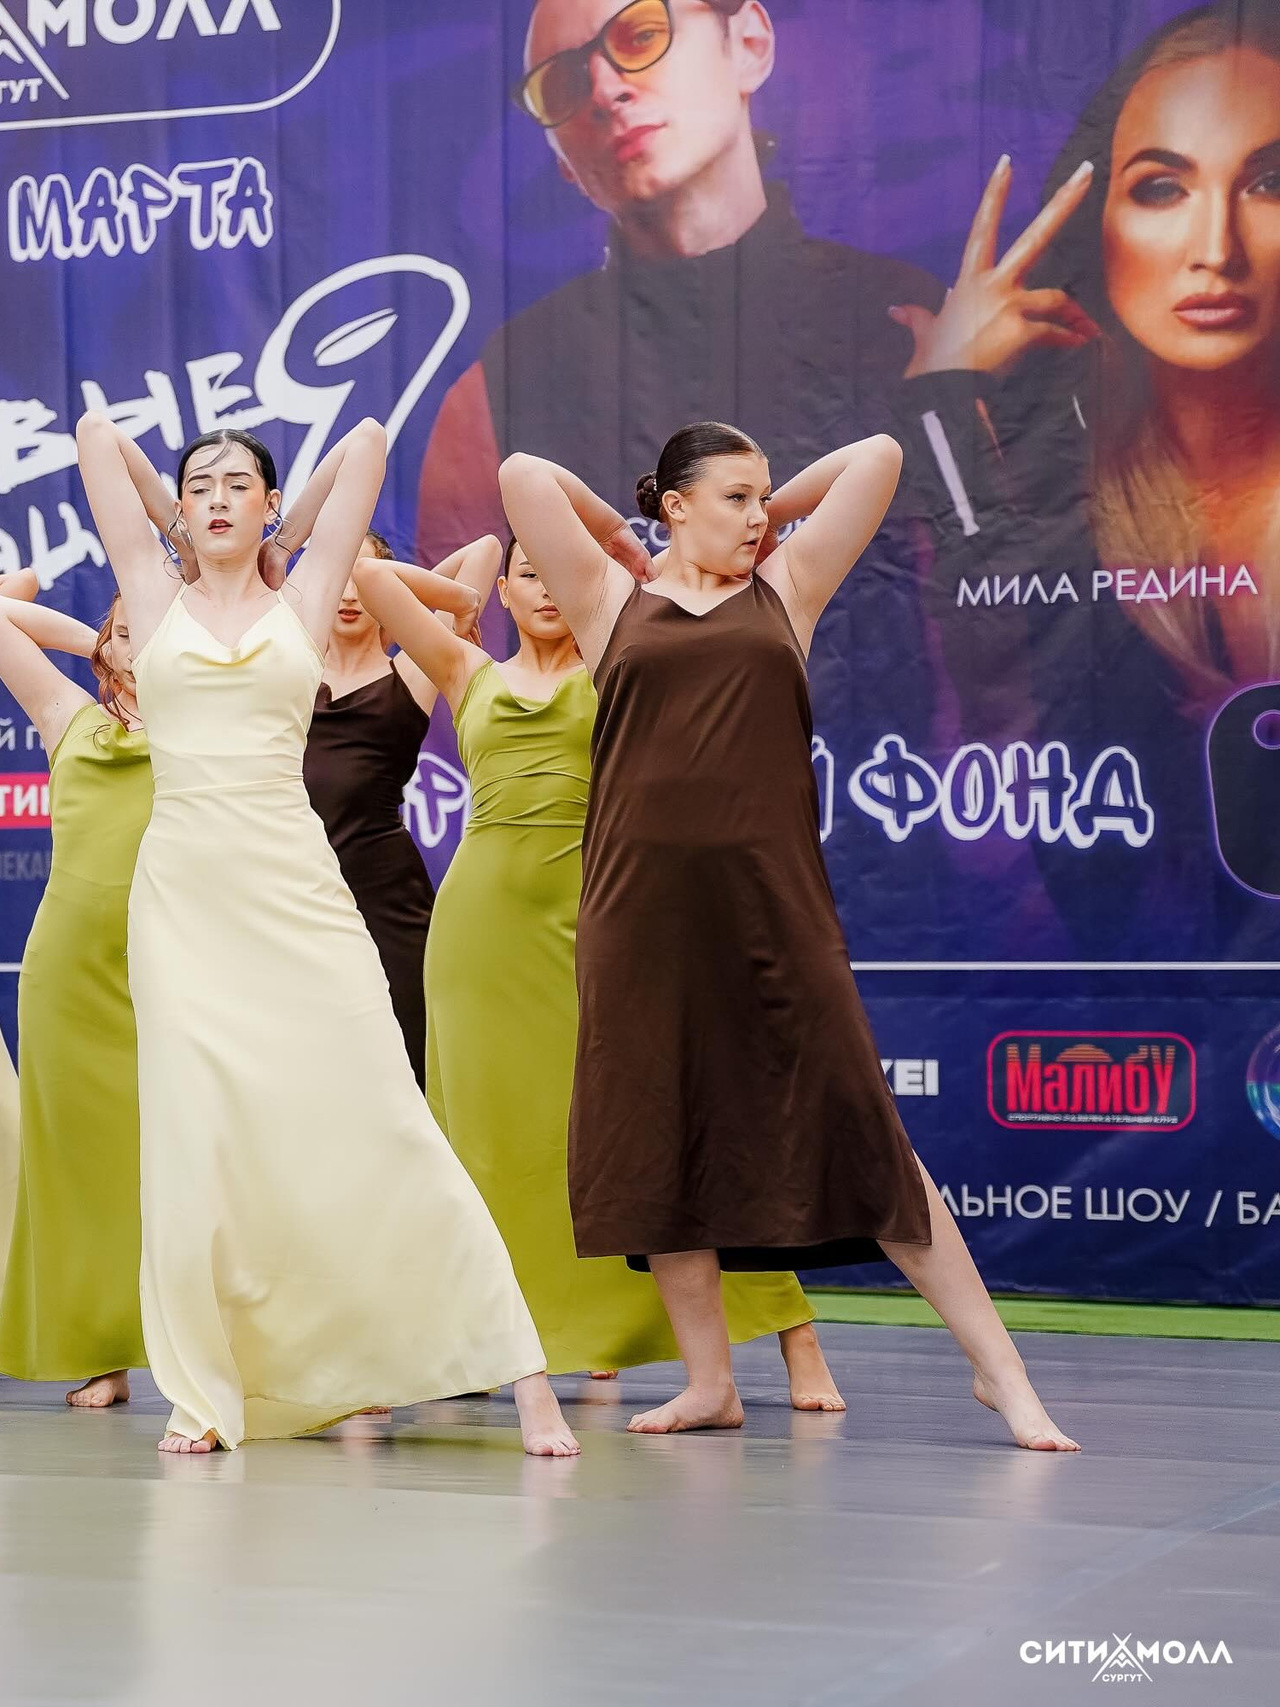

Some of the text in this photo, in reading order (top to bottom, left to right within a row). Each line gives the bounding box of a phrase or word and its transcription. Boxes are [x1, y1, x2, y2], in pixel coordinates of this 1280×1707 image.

[8, 156, 275, 263] МАРТА
[956, 564, 1259, 607] МИЛА РЕДИНА
[847, 733, 1155, 849] ФОНД
[1085, 1187, 1191, 1223] ШОУ
